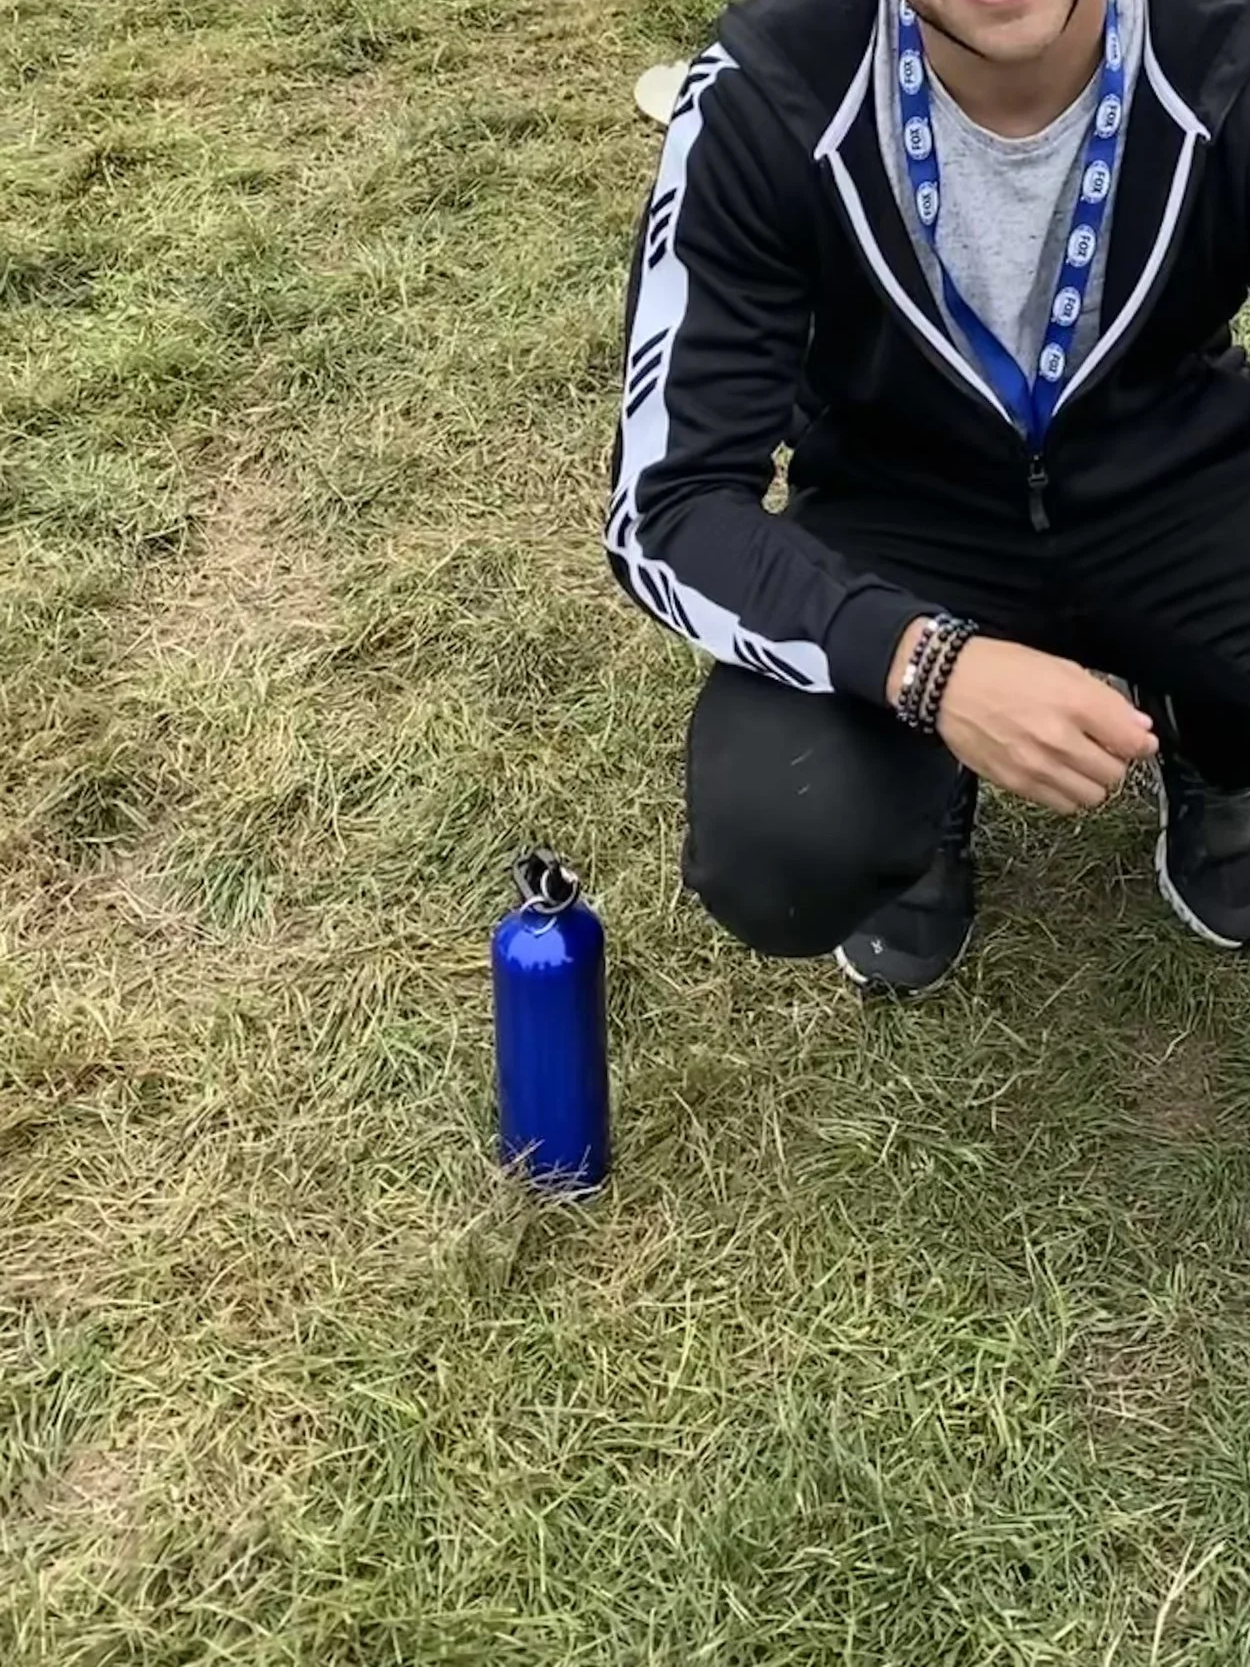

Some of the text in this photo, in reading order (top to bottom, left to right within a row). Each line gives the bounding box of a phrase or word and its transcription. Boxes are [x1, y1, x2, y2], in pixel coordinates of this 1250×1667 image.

[1105, 104, 1118, 127] FOX
[910, 128, 922, 151] FOX
[1093, 171, 1106, 194] FOX
[922, 193, 932, 217] FOX
[1078, 234, 1091, 257] FOX
[1063, 296, 1077, 319] FOX
[1049, 352, 1061, 374] FOX
